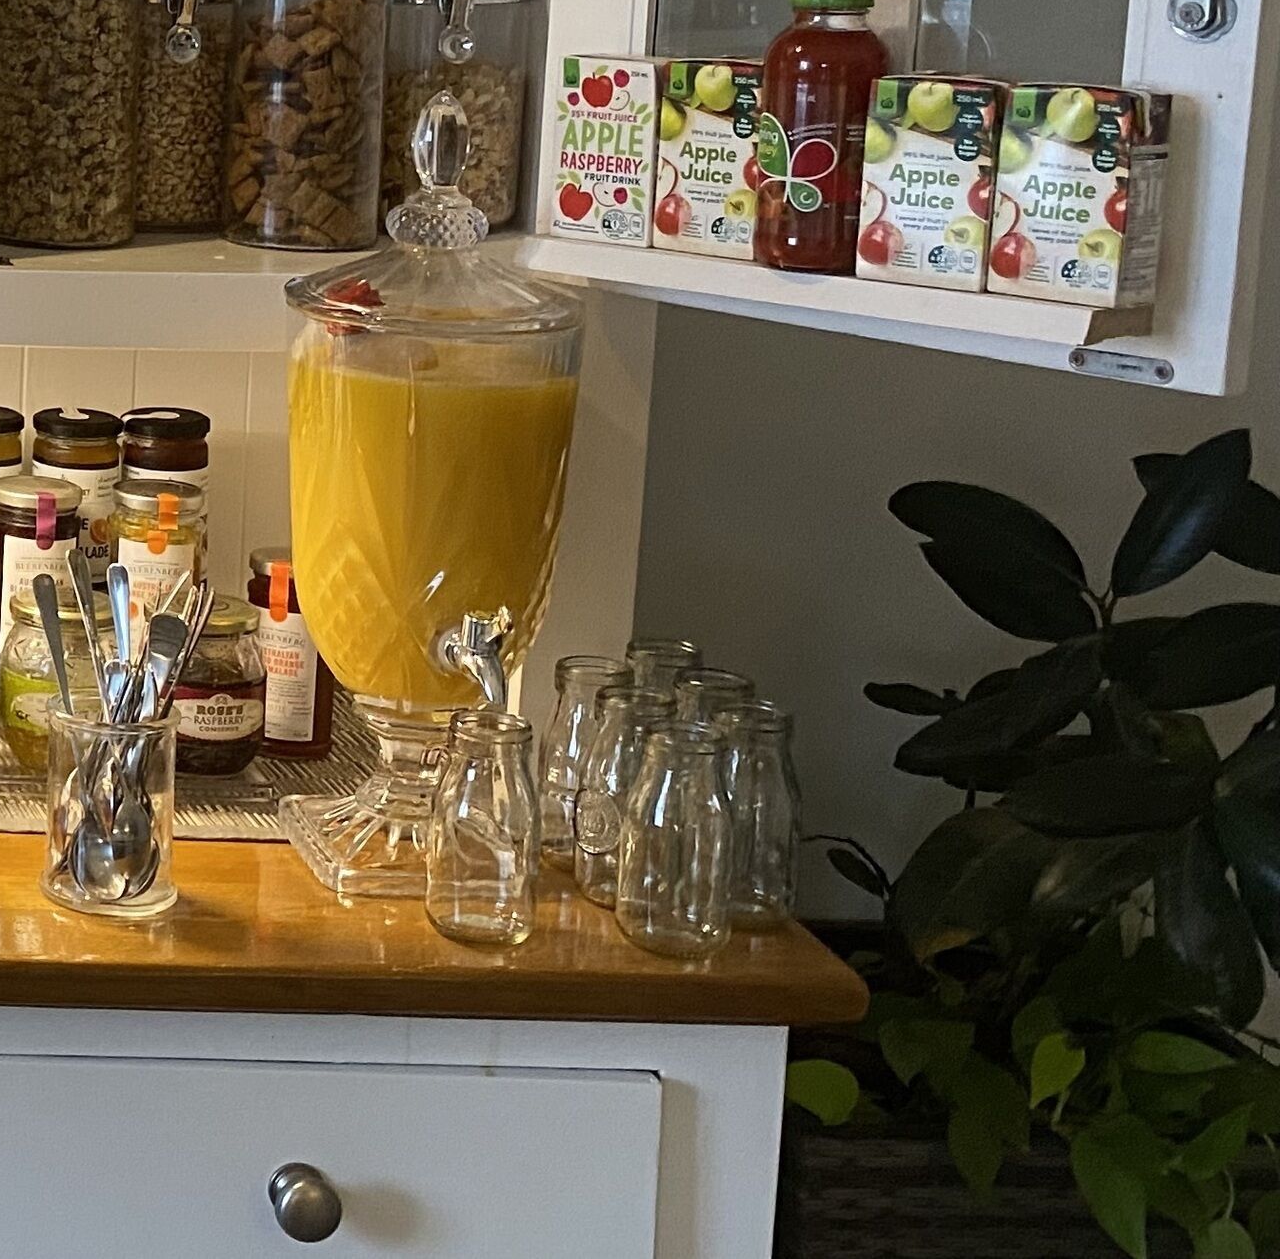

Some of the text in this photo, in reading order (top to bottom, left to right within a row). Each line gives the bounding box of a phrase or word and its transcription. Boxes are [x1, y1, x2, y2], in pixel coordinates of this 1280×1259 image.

[562, 119, 643, 157] APPLE
[561, 152, 643, 175] RASPBERRY
[680, 142, 736, 166] Apple
[584, 172, 641, 186] FRUIT DRINK
[681, 164, 732, 184] Juice
[889, 164, 960, 191] Apple
[891, 188, 954, 210] Juice
[1023, 175, 1096, 201] Apple
[1024, 200, 1090, 223] Juice
[194, 716, 243, 725] RASPBERRY
